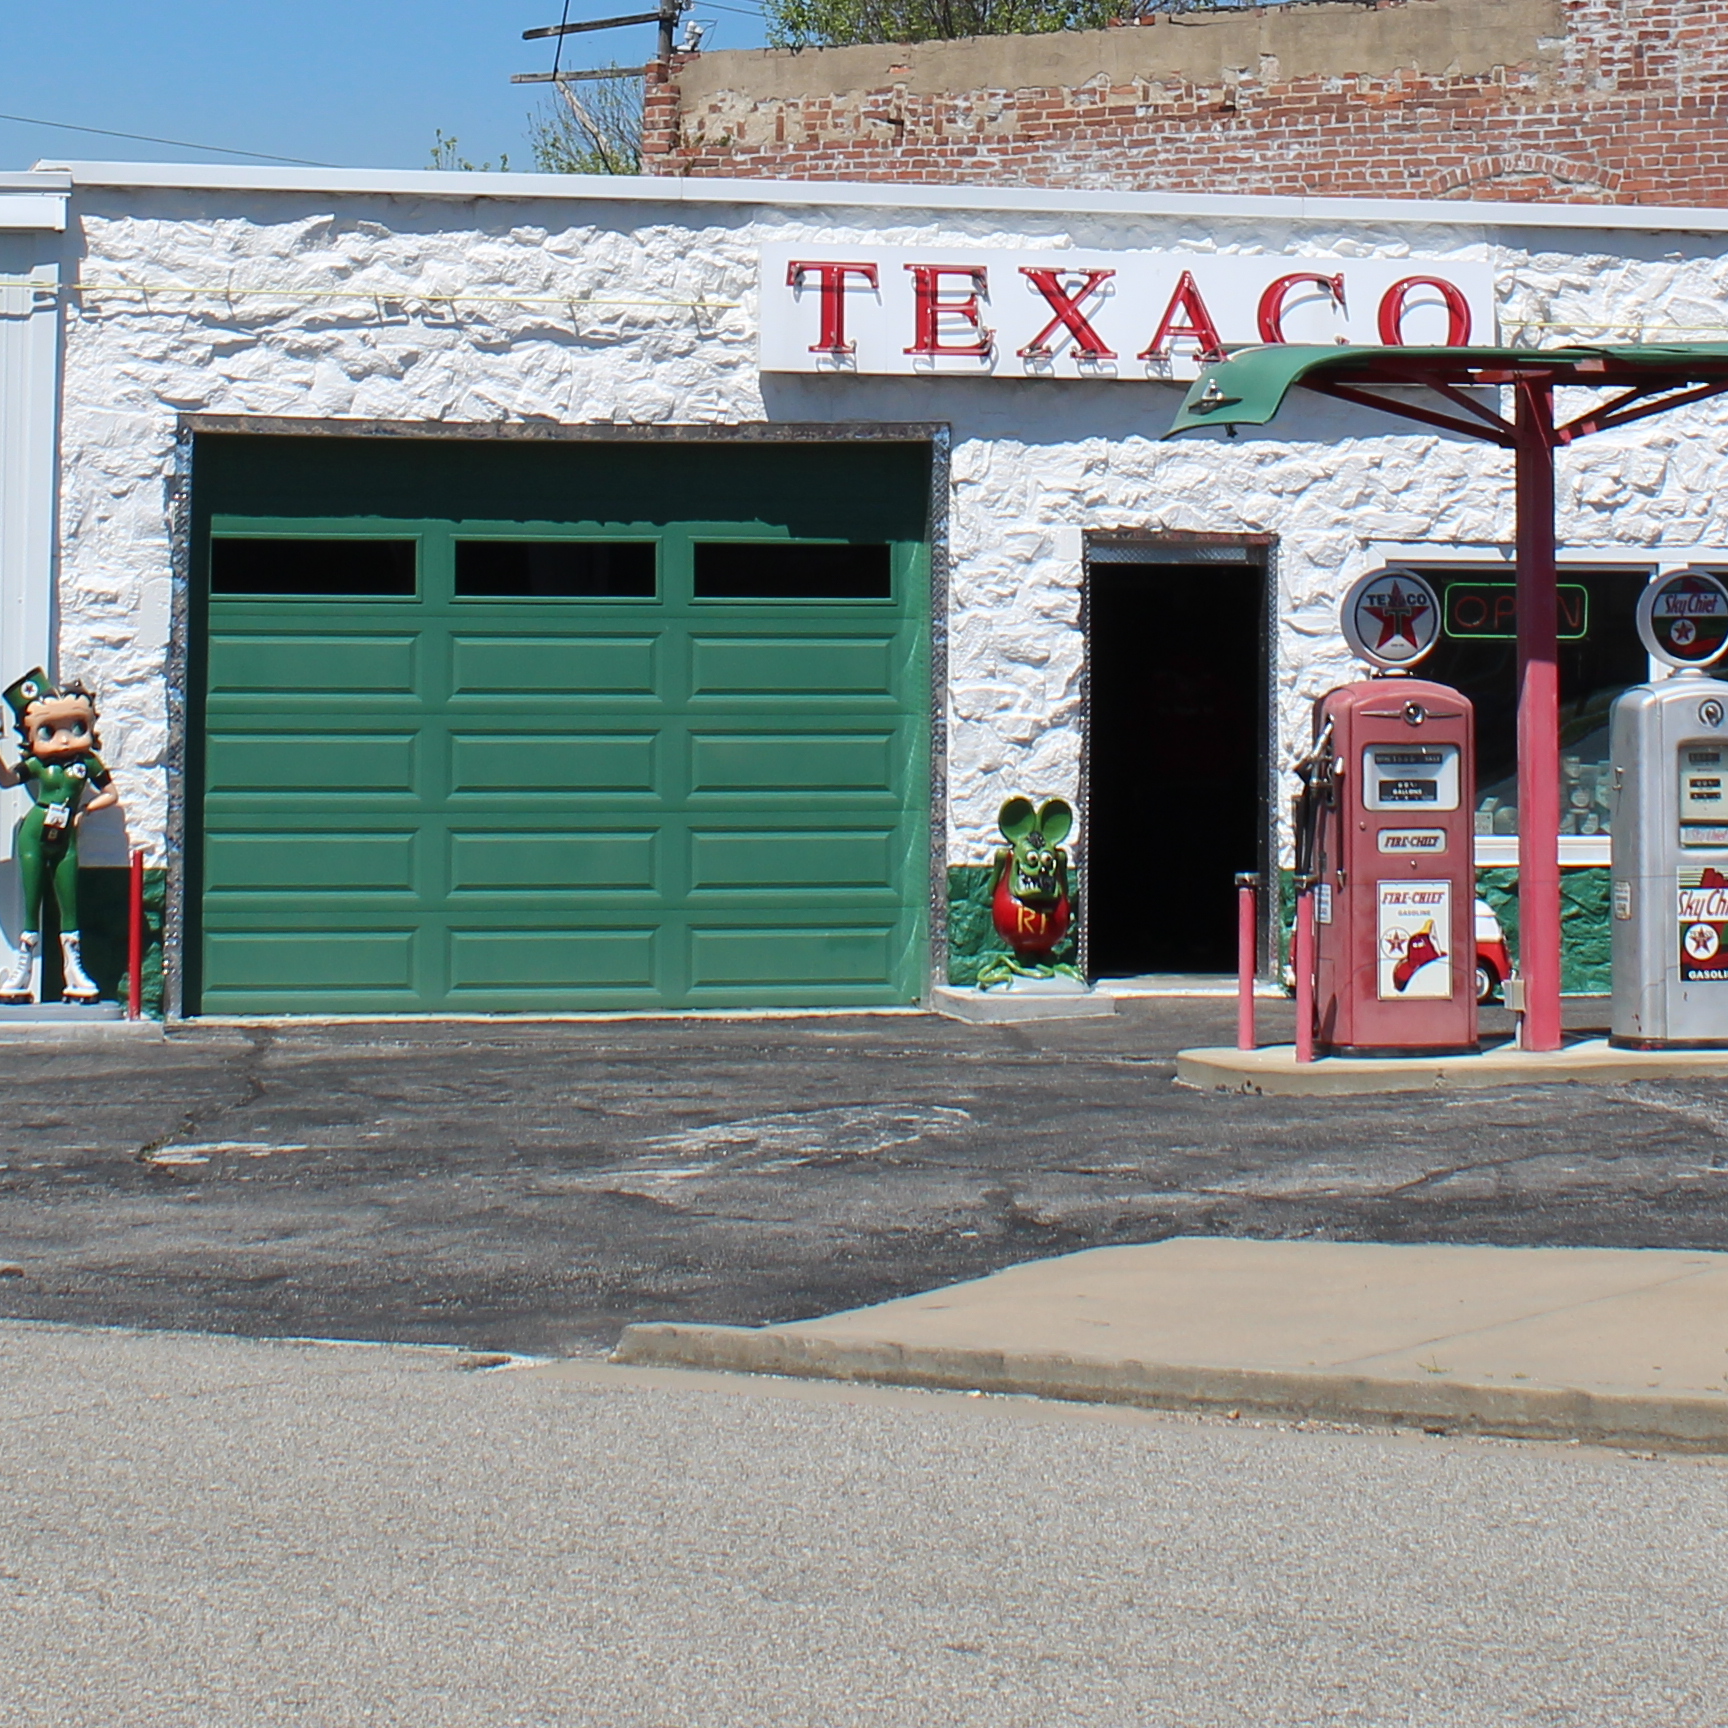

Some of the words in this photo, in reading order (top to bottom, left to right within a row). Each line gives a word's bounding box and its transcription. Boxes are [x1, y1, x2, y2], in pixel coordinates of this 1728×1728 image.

[786, 260, 1473, 362] TEXACO
[1366, 593, 1428, 607] TEXACO
[1665, 593, 1687, 617] Sky
[1687, 592, 1718, 614] Chief
[1454, 595, 1581, 630] OPN
[1384, 836, 1440, 848] FIRE-CHIEF
[1381, 891, 1445, 905] FIRE-CHIEF
[1678, 890, 1705, 922] Sky
[1398, 909, 1432, 917] GASOLINE
